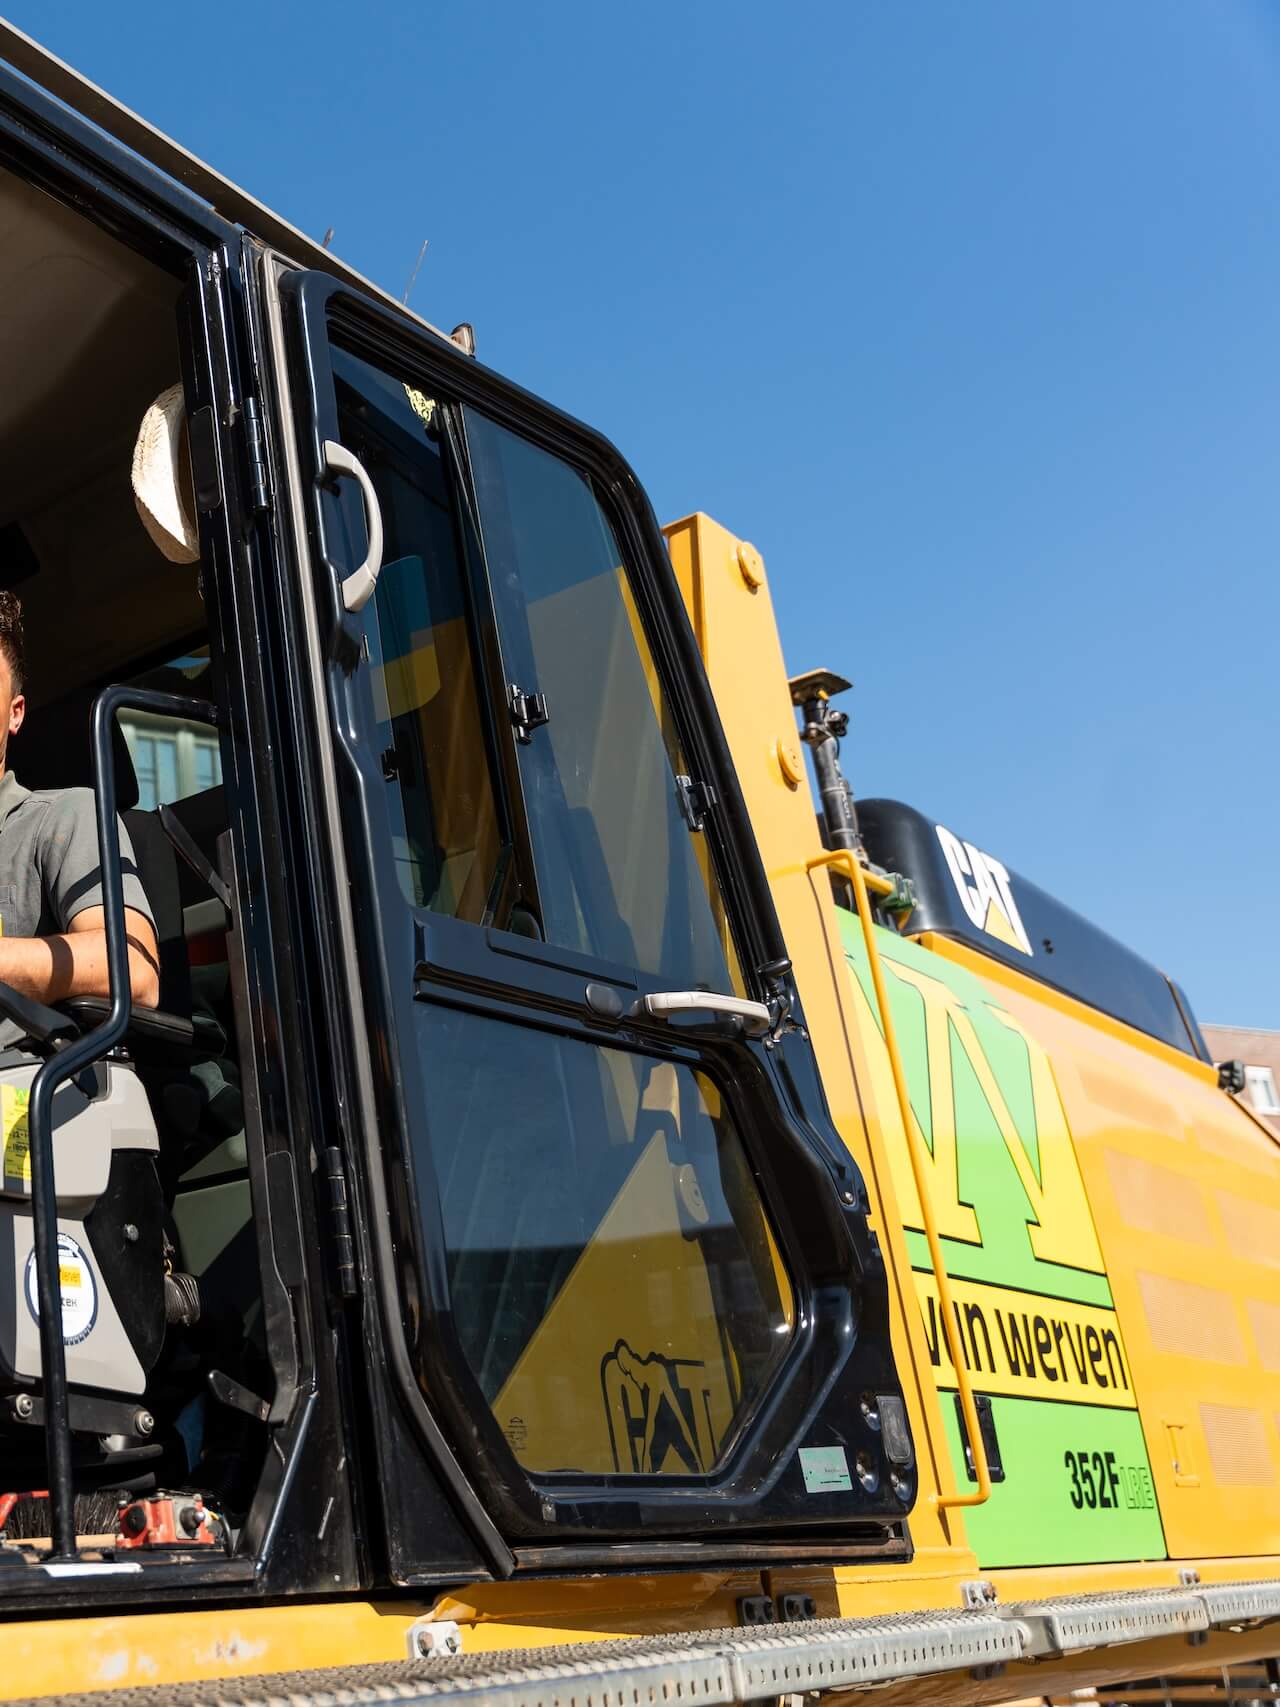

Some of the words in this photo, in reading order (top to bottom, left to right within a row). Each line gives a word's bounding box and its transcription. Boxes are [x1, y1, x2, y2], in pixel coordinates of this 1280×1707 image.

[935, 825, 1034, 957] CAT
[994, 1309, 1128, 1390] werven
[1064, 1450, 1120, 1509] 352F
